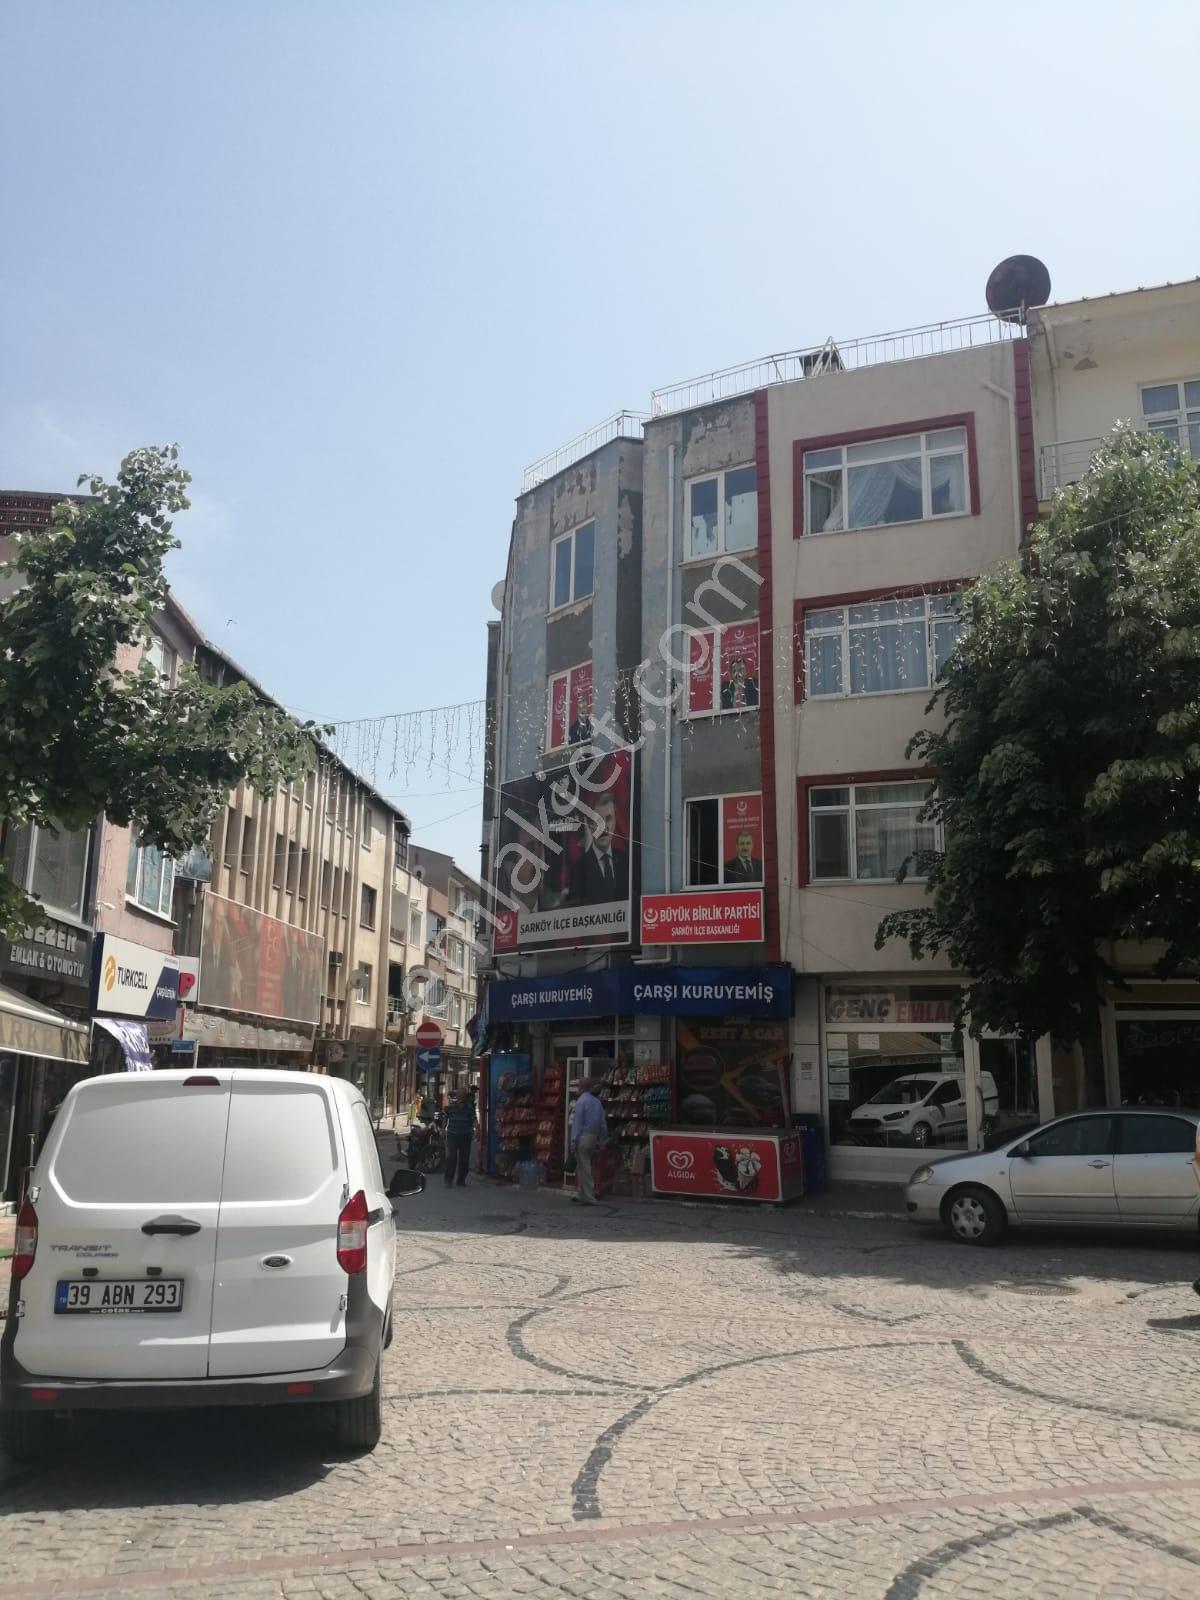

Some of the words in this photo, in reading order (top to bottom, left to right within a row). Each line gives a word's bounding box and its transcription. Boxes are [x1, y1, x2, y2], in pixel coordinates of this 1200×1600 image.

[520, 918, 551, 935] ŞARKÖY
[553, 917, 570, 931] İLÇE
[572, 908, 626, 929] BAŞKANLIĞI
[660, 906, 691, 922] BÜYÜK
[692, 904, 722, 921] BİRLİK
[724, 902, 760, 919] PARTİSİ
[671, 926, 693, 936] ŞARKÖY
[694, 925, 706, 936] İLÇE
[706, 924, 740, 936] BAŞKANLIĞI
[10, 944, 38, 969] EMLAK
[39, 951, 45, 968] &
[47, 957, 85, 978] OTOMOTİV
[117, 967, 148, 990] TURKCELL
[511, 986, 538, 1007] ÇARŞI
[539, 983, 593, 1005] KURUYEMİŞ
[633, 983, 678, 1001] ÇARŞI
[682, 980, 774, 1003] KURUYEMİŞ
[831, 997, 891, 1023] GENÇ
[754, 1026, 785, 1040] CAR
[667, 1170, 695, 1179] ALGIDA
[50, 1244, 113, 1252] TRANSIT
[69, 1284, 91, 1305] 39
[101, 1284, 135, 1305] ABN
[144, 1283, 177, 1304] 293
